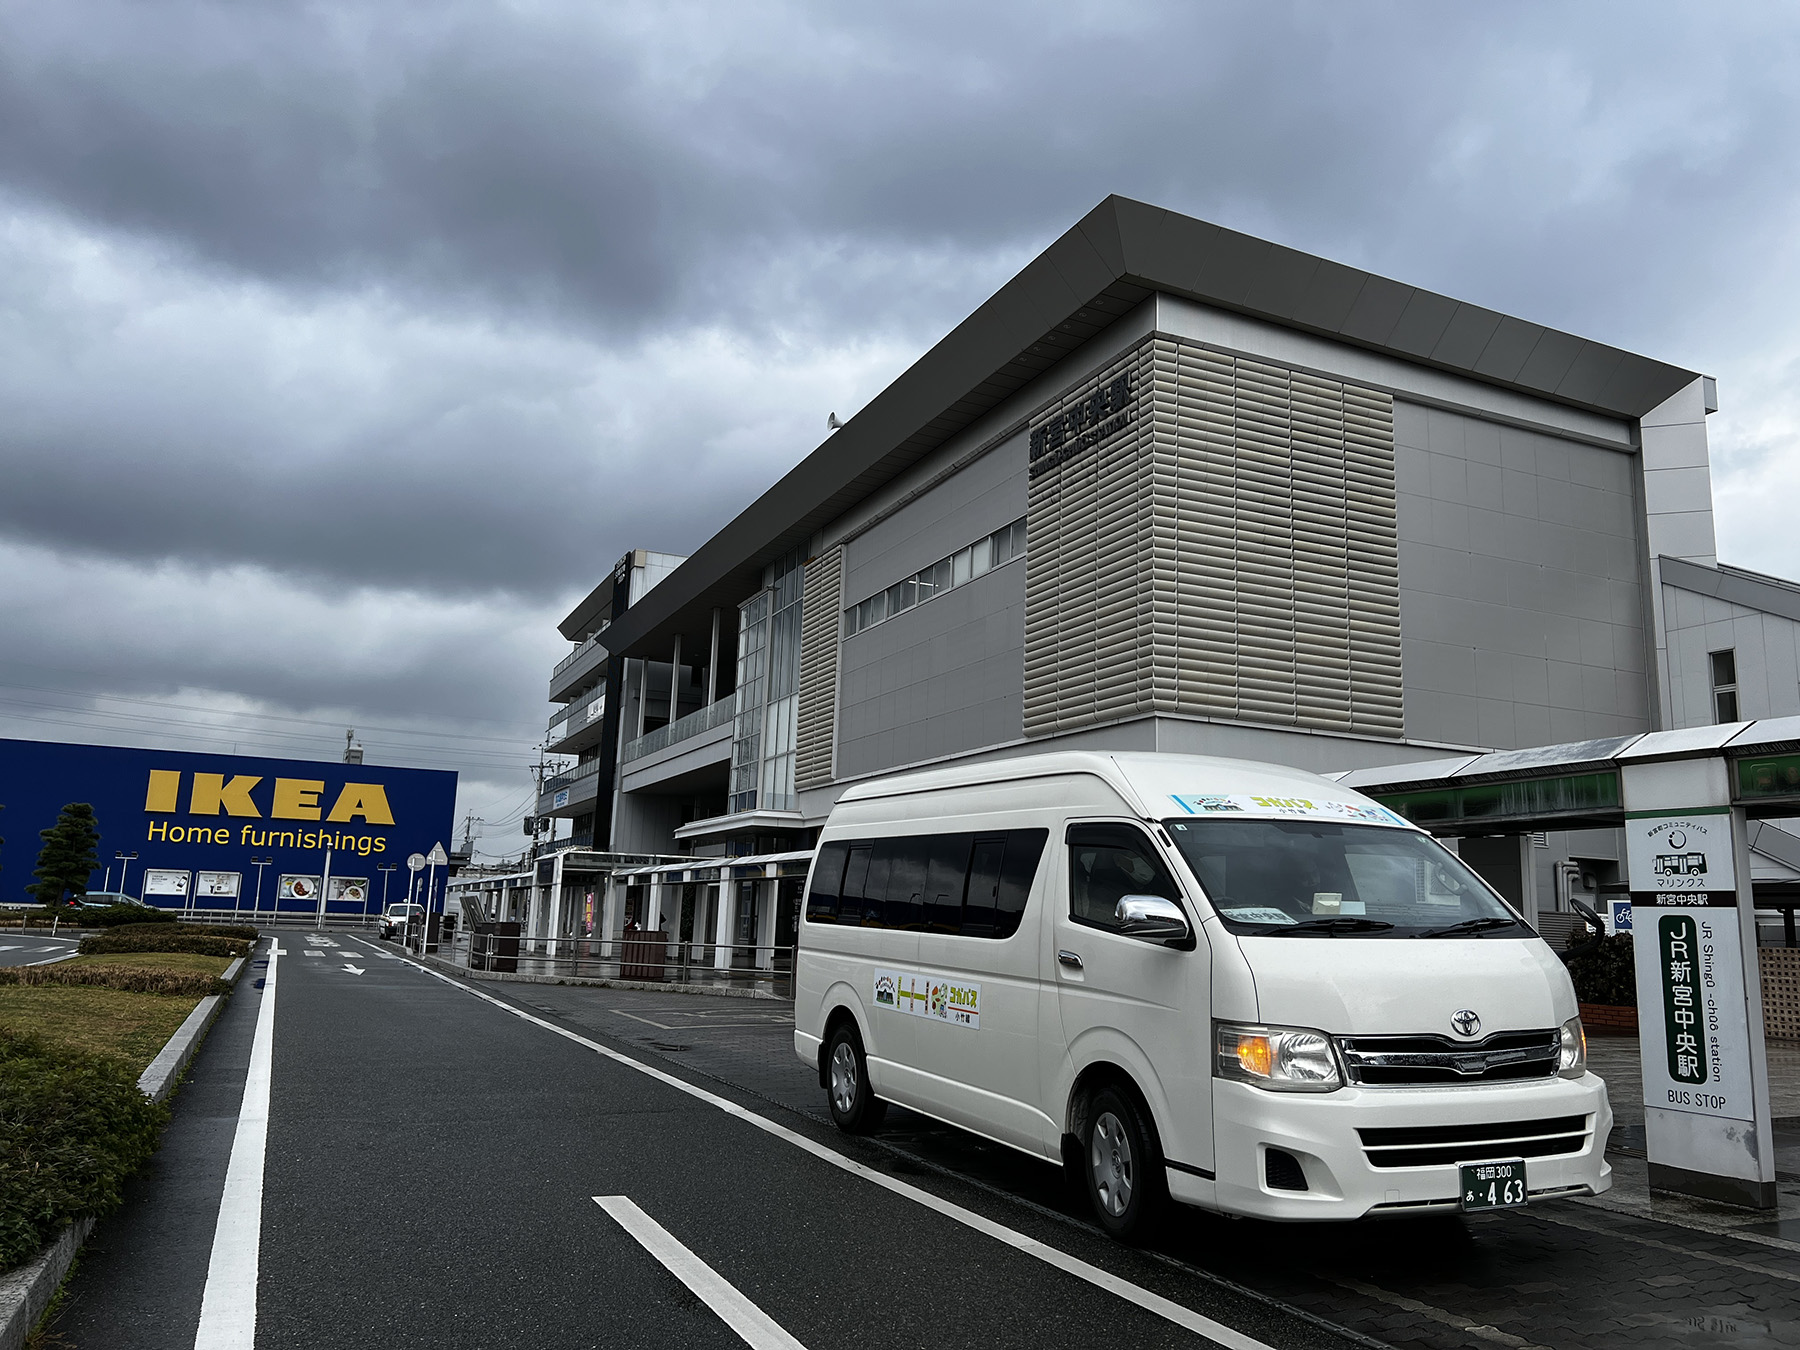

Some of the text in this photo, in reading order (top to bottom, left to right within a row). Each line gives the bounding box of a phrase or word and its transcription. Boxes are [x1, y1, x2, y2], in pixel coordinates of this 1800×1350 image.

[144, 769, 396, 825] IKEA
[1249, 796, 1319, 811] コガバス
[147, 820, 387, 856] Home furnishings
[1656, 893, 1709, 906] 新宮中央駅
[949, 986, 977, 1009] コガバス
[1670, 921, 1700, 1079] JR新宮中央駅
[1701, 921, 1713, 940] JR
[1710, 1036, 1721, 1083] station
[1667, 1089, 1726, 1110] BUS STOP
